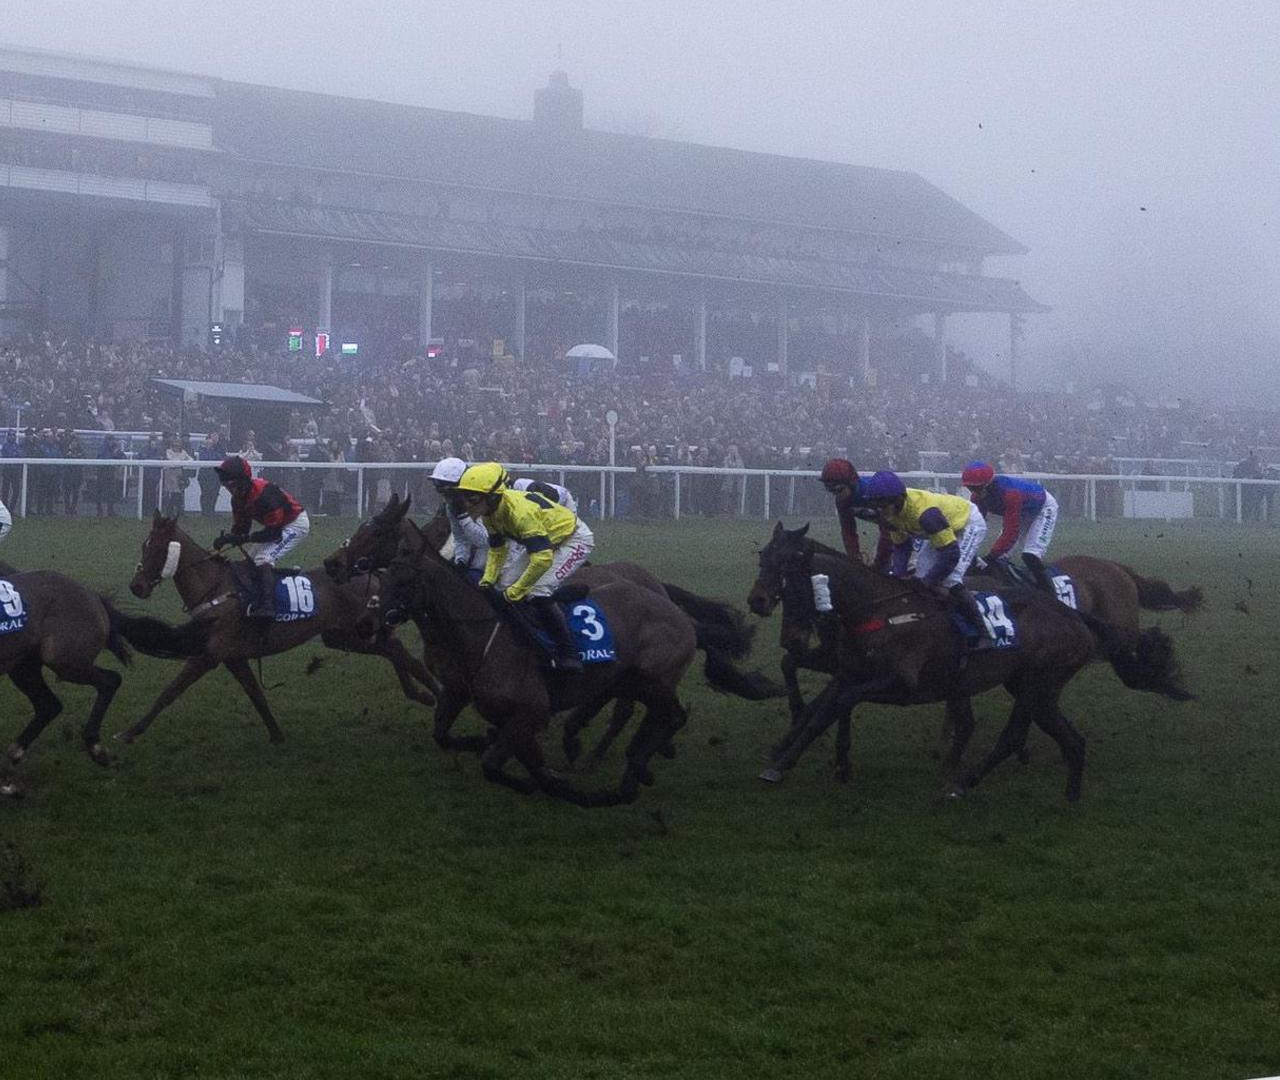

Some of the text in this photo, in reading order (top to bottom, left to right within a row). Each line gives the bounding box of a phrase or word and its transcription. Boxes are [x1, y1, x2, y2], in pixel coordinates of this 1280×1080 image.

[281, 576, 314, 612] 16
[572, 605, 604, 641] 3
[578, 650, 611, 661] RAL
